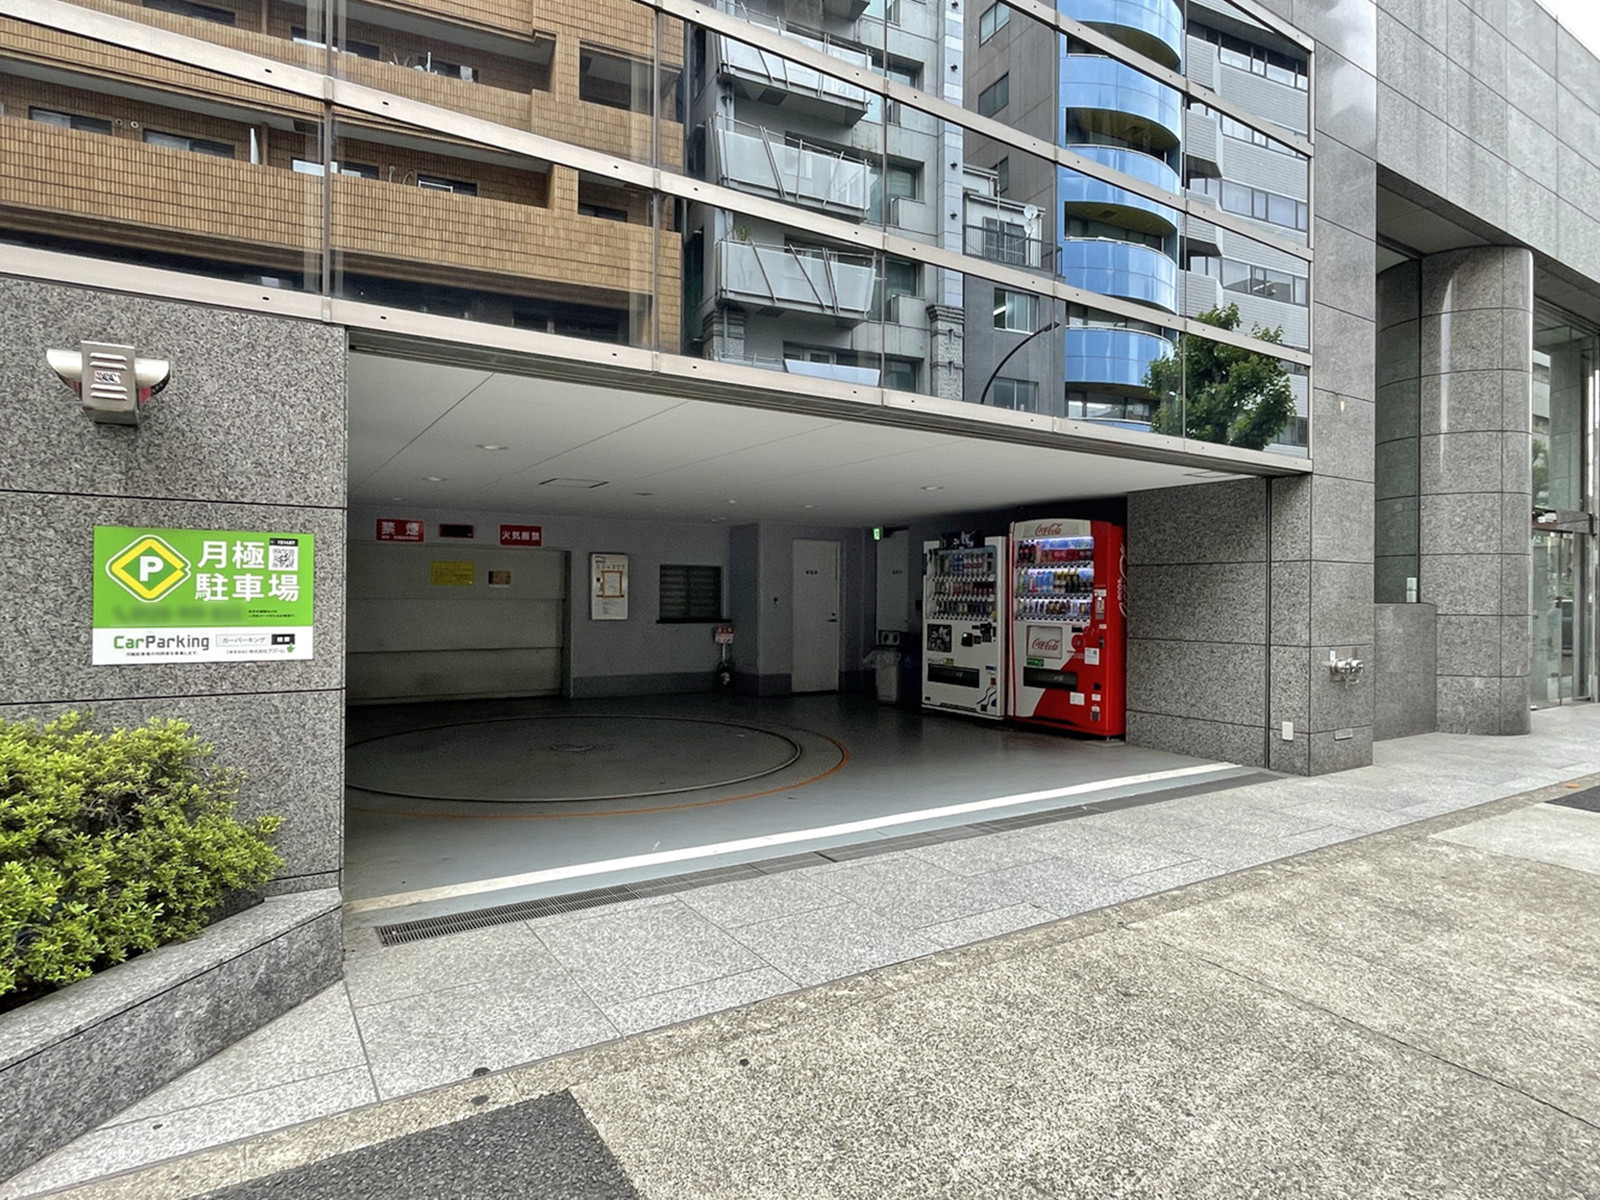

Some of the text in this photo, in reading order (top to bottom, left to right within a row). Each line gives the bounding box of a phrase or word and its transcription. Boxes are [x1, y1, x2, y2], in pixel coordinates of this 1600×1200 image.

[1034, 522, 1063, 536] Coca-Cola
[197, 540, 265, 569] 月極
[139, 555, 164, 582] P
[194, 574, 301, 602] 駐車場
[113, 634, 210, 651] CarParking
[1032, 637, 1060, 651] Coca-Cola
